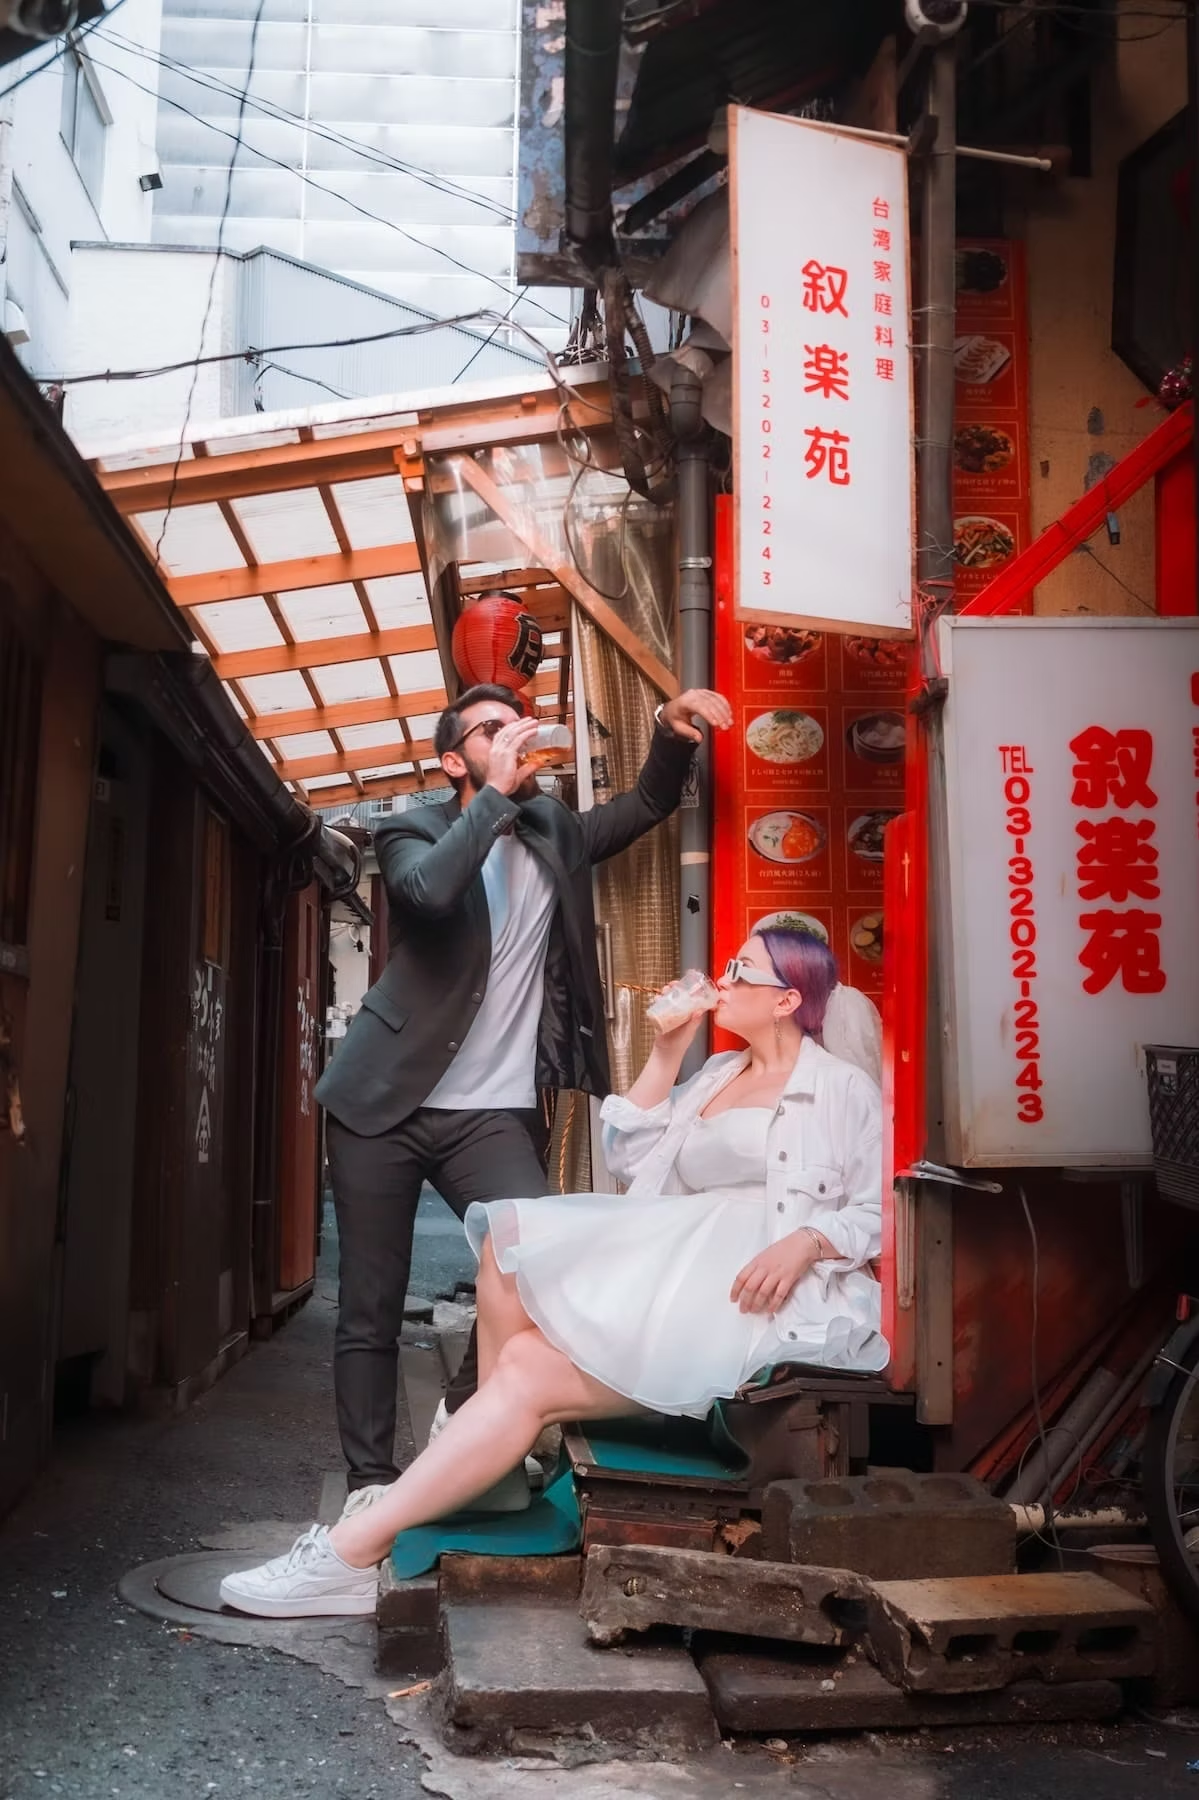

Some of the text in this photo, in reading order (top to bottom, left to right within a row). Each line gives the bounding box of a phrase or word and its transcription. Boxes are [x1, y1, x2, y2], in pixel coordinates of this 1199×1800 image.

[801, 258, 851, 486] 叙楽苑
[872, 196, 895, 382] 台湾家庭料理
[760, 295, 772, 585] 03-3202-2243
[998, 744, 1044, 1124] TEL 03-3202-2243
[1068, 725, 1167, 995] 叙楽苑
